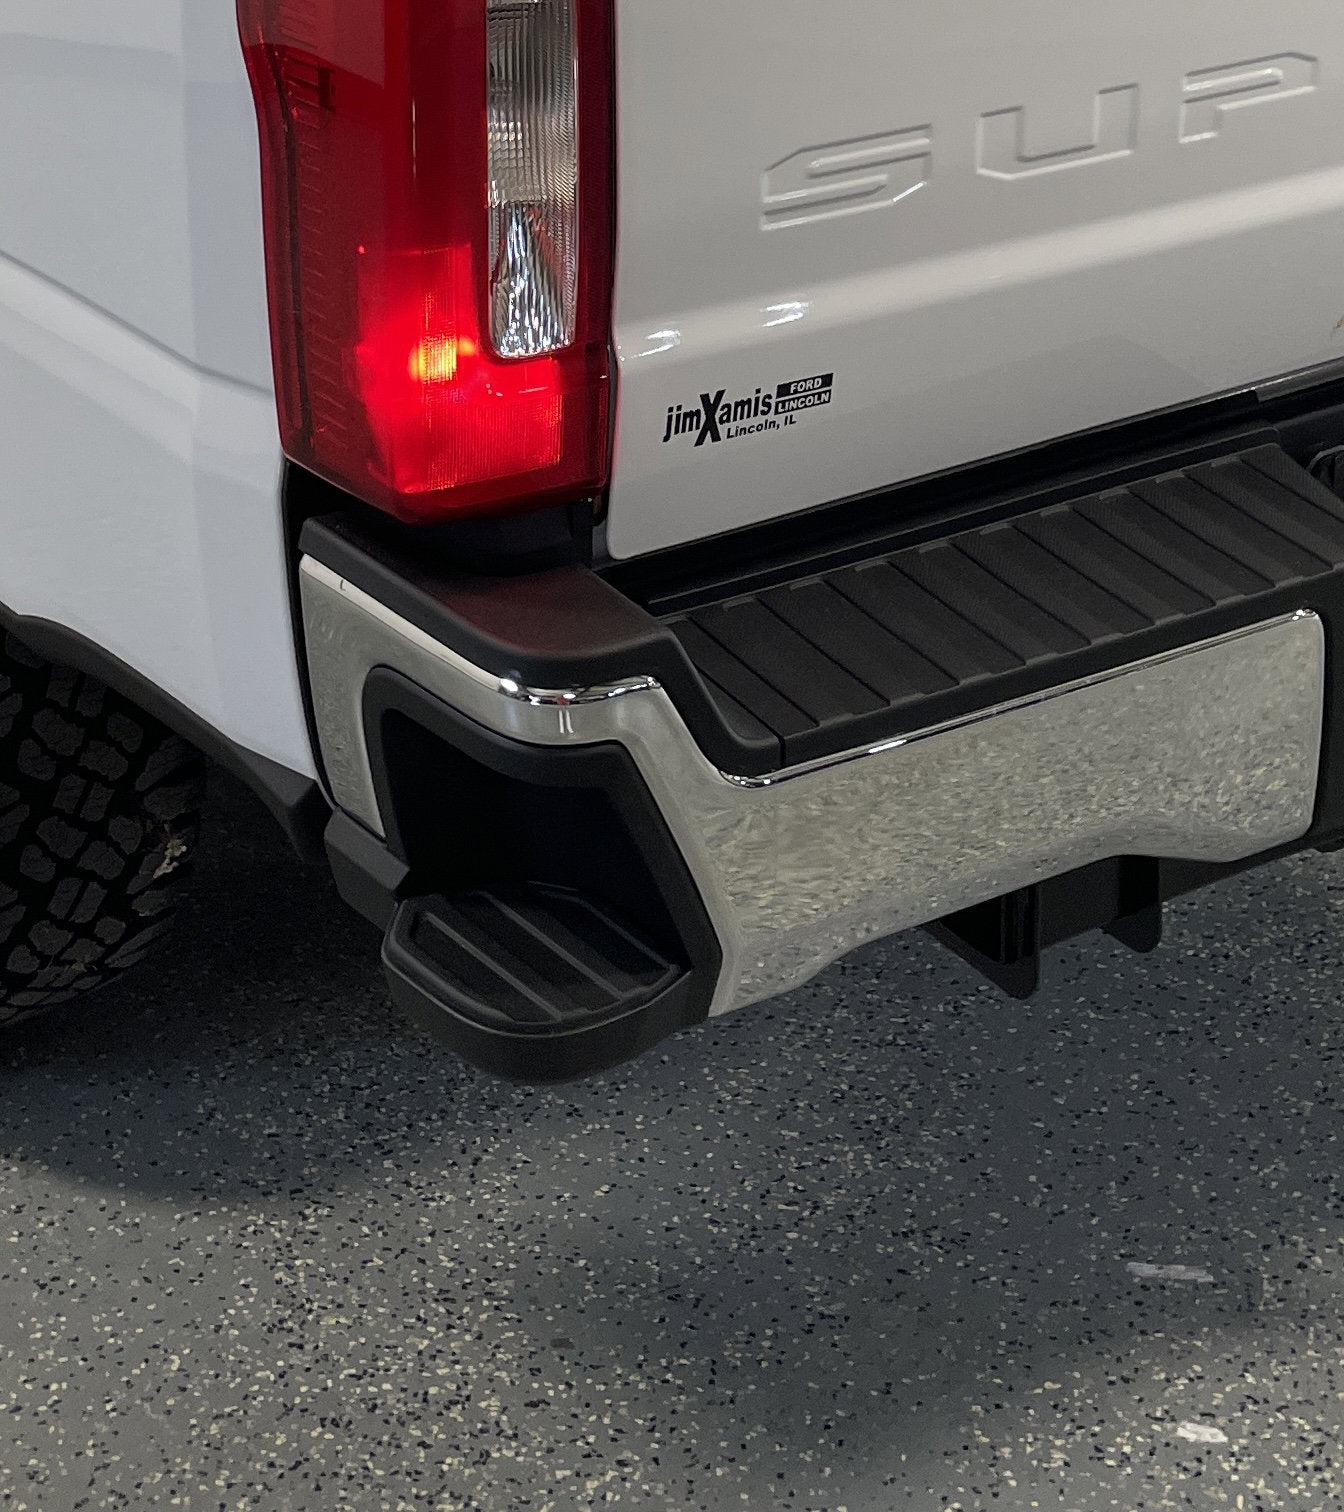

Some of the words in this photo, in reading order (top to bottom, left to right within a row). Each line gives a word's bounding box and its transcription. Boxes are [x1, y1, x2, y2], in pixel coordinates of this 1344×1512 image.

[790, 377, 823, 394] FORD
[776, 392, 830, 413] LINCOLN
[726, 418, 780, 439] Lincoln,
[784, 414, 798, 426] IL
